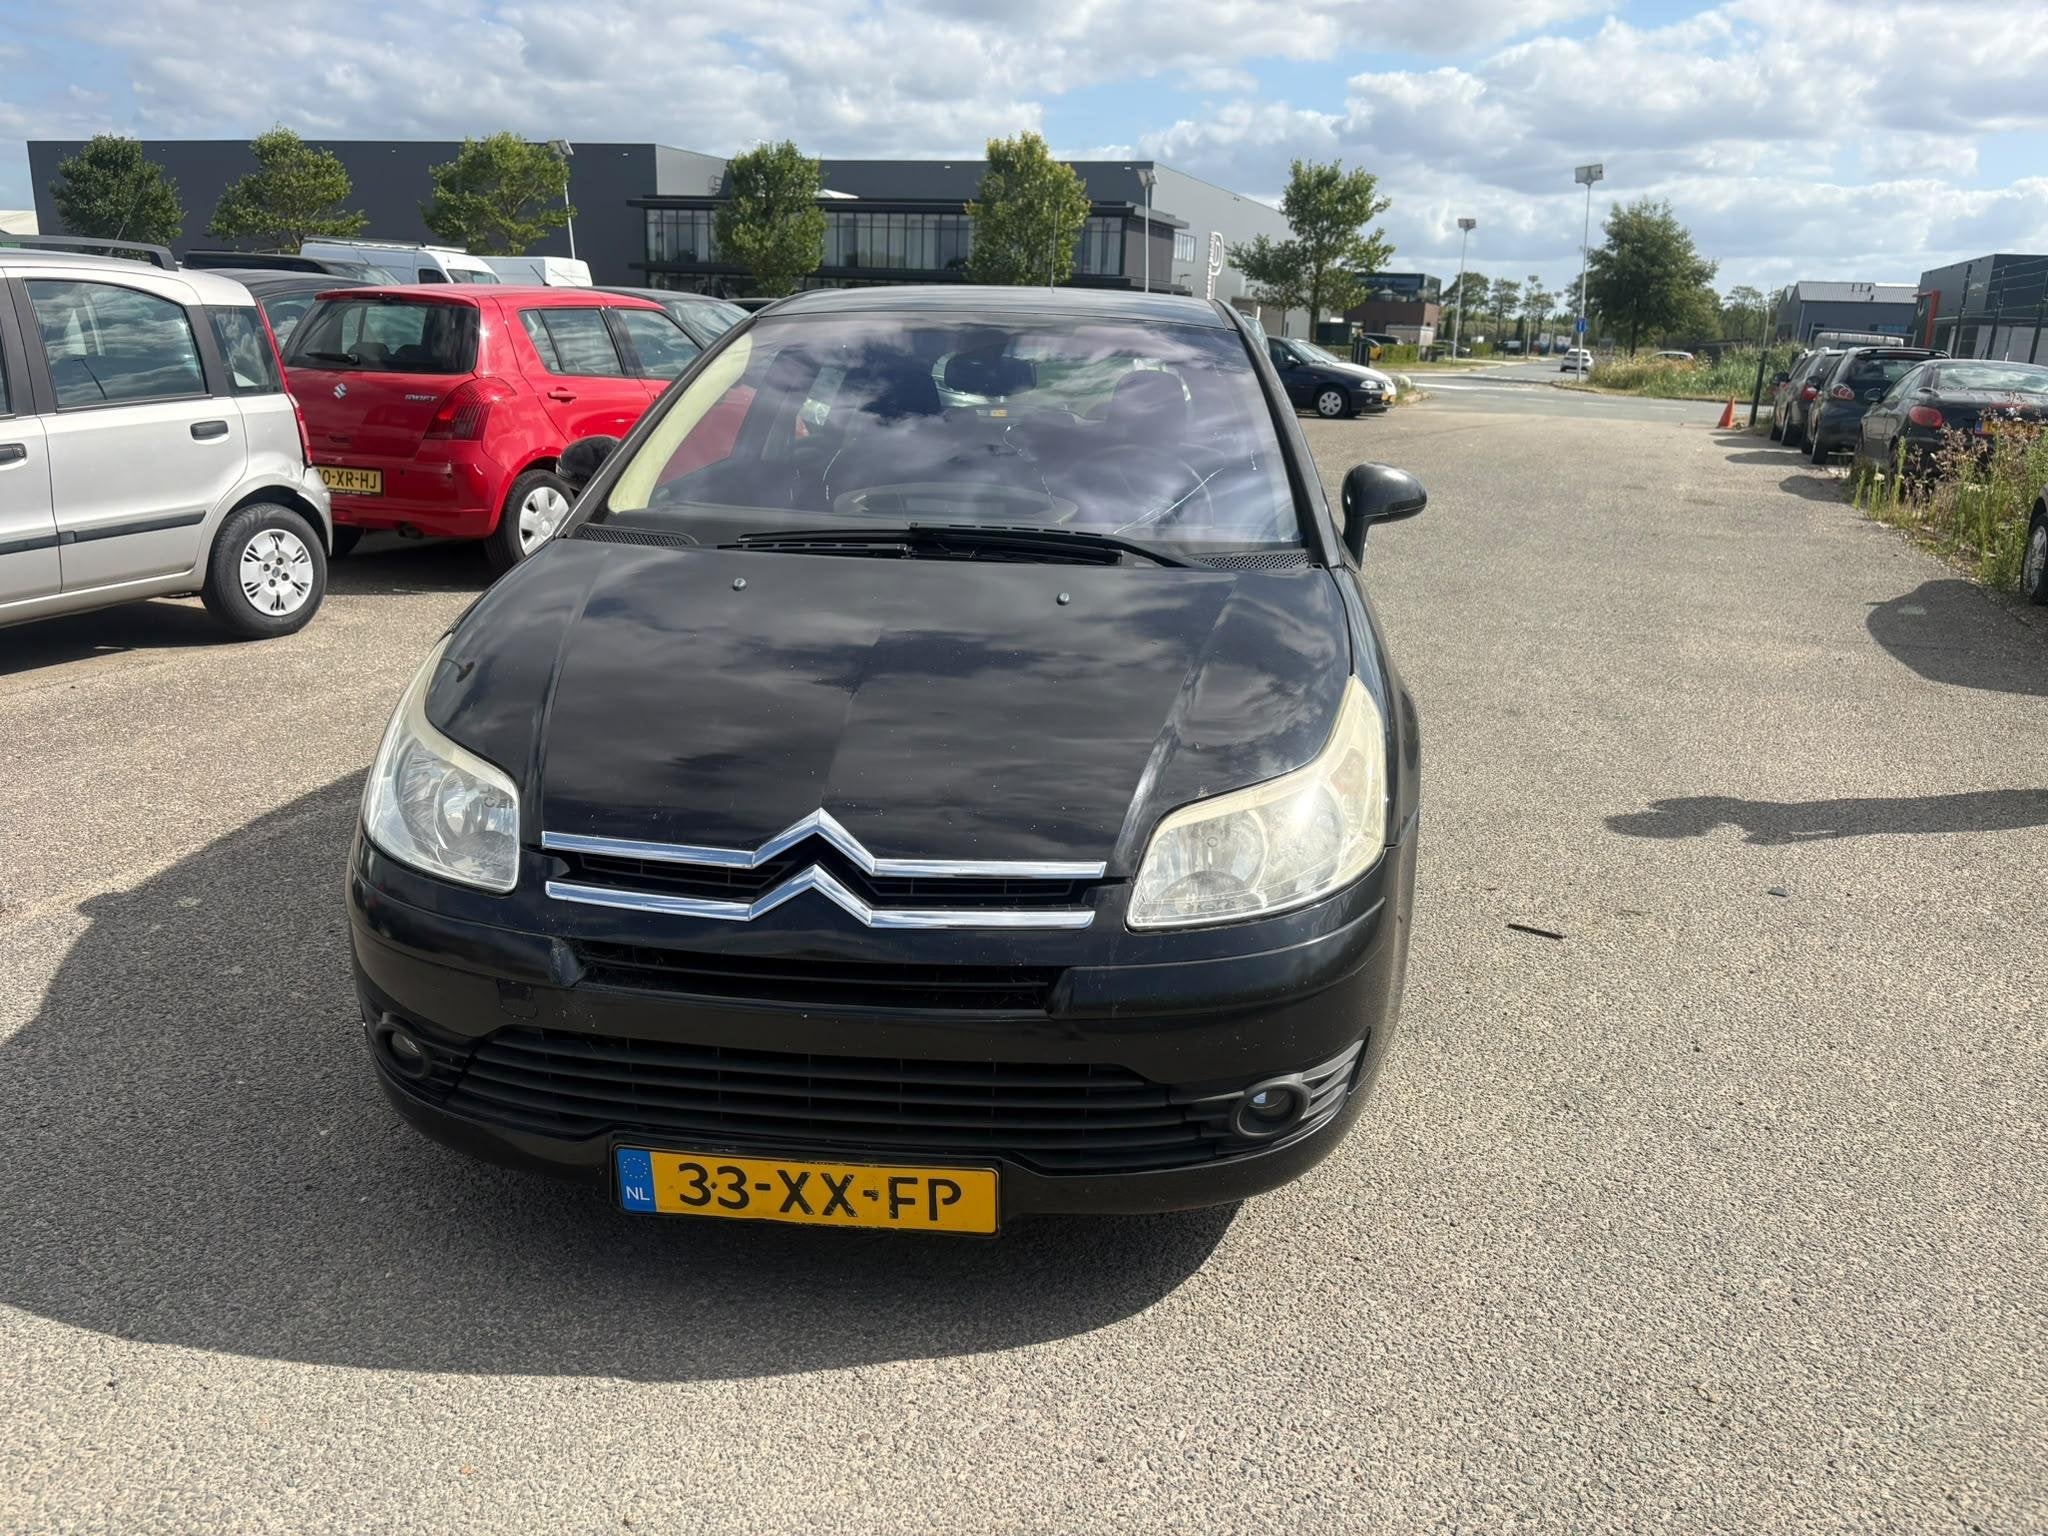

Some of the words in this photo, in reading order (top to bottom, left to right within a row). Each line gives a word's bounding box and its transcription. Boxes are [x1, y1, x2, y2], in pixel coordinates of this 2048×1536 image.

[318, 469, 377, 489] 0-XR-HJ
[625, 1184, 651, 1201] NL
[677, 1161, 963, 1222] 33-XX-FP
